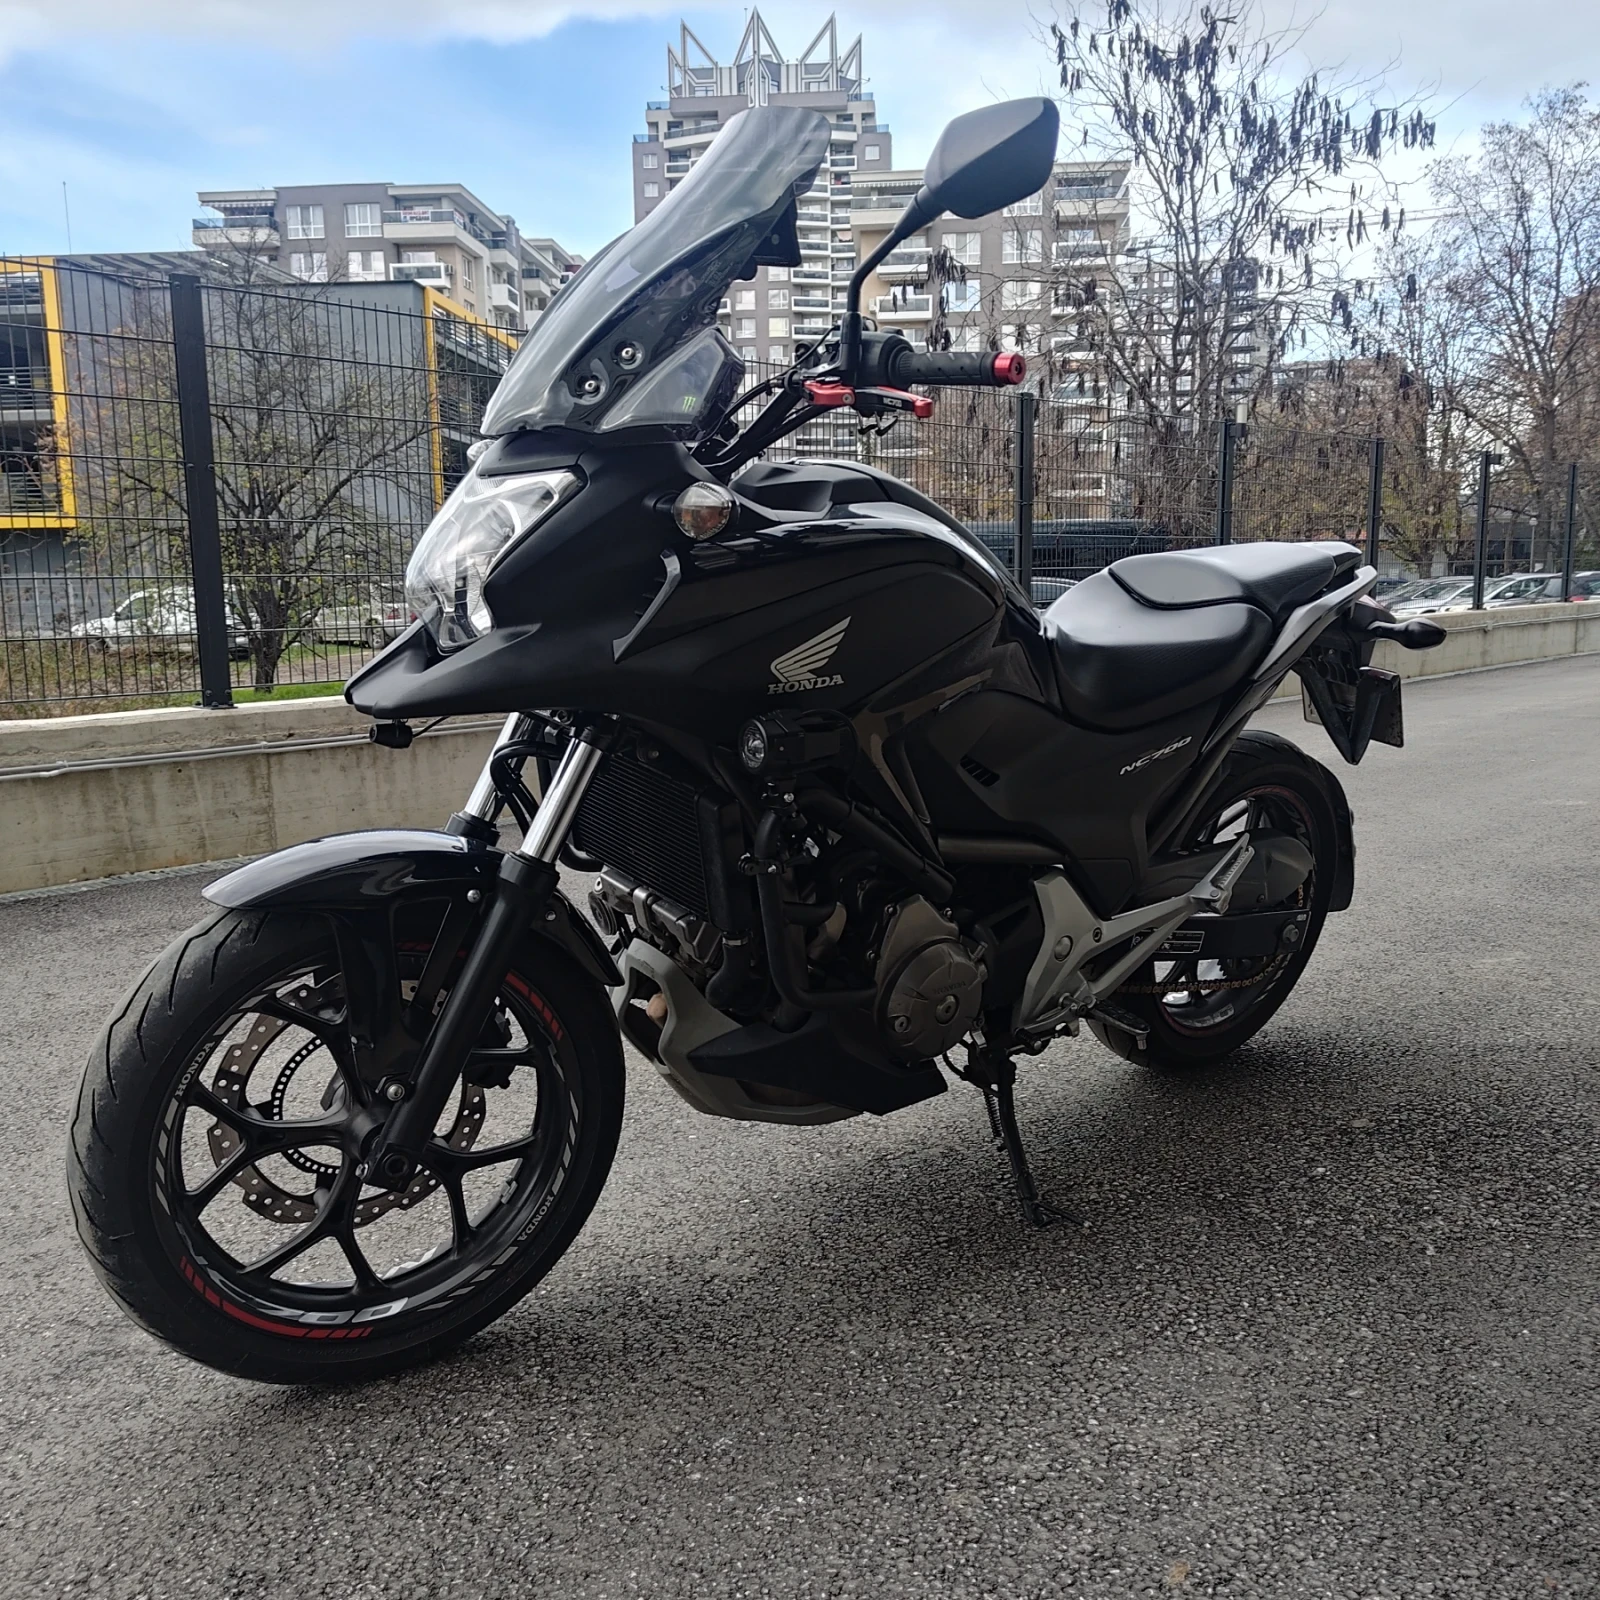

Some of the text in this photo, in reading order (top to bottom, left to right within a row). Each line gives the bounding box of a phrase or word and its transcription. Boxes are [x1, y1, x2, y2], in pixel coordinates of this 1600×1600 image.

[766, 674, 845, 695] HONDA
[1119, 736, 1193, 776] NC700
[175, 1041, 216, 1097] HONDA
[517, 1195, 555, 1242] HONDA
